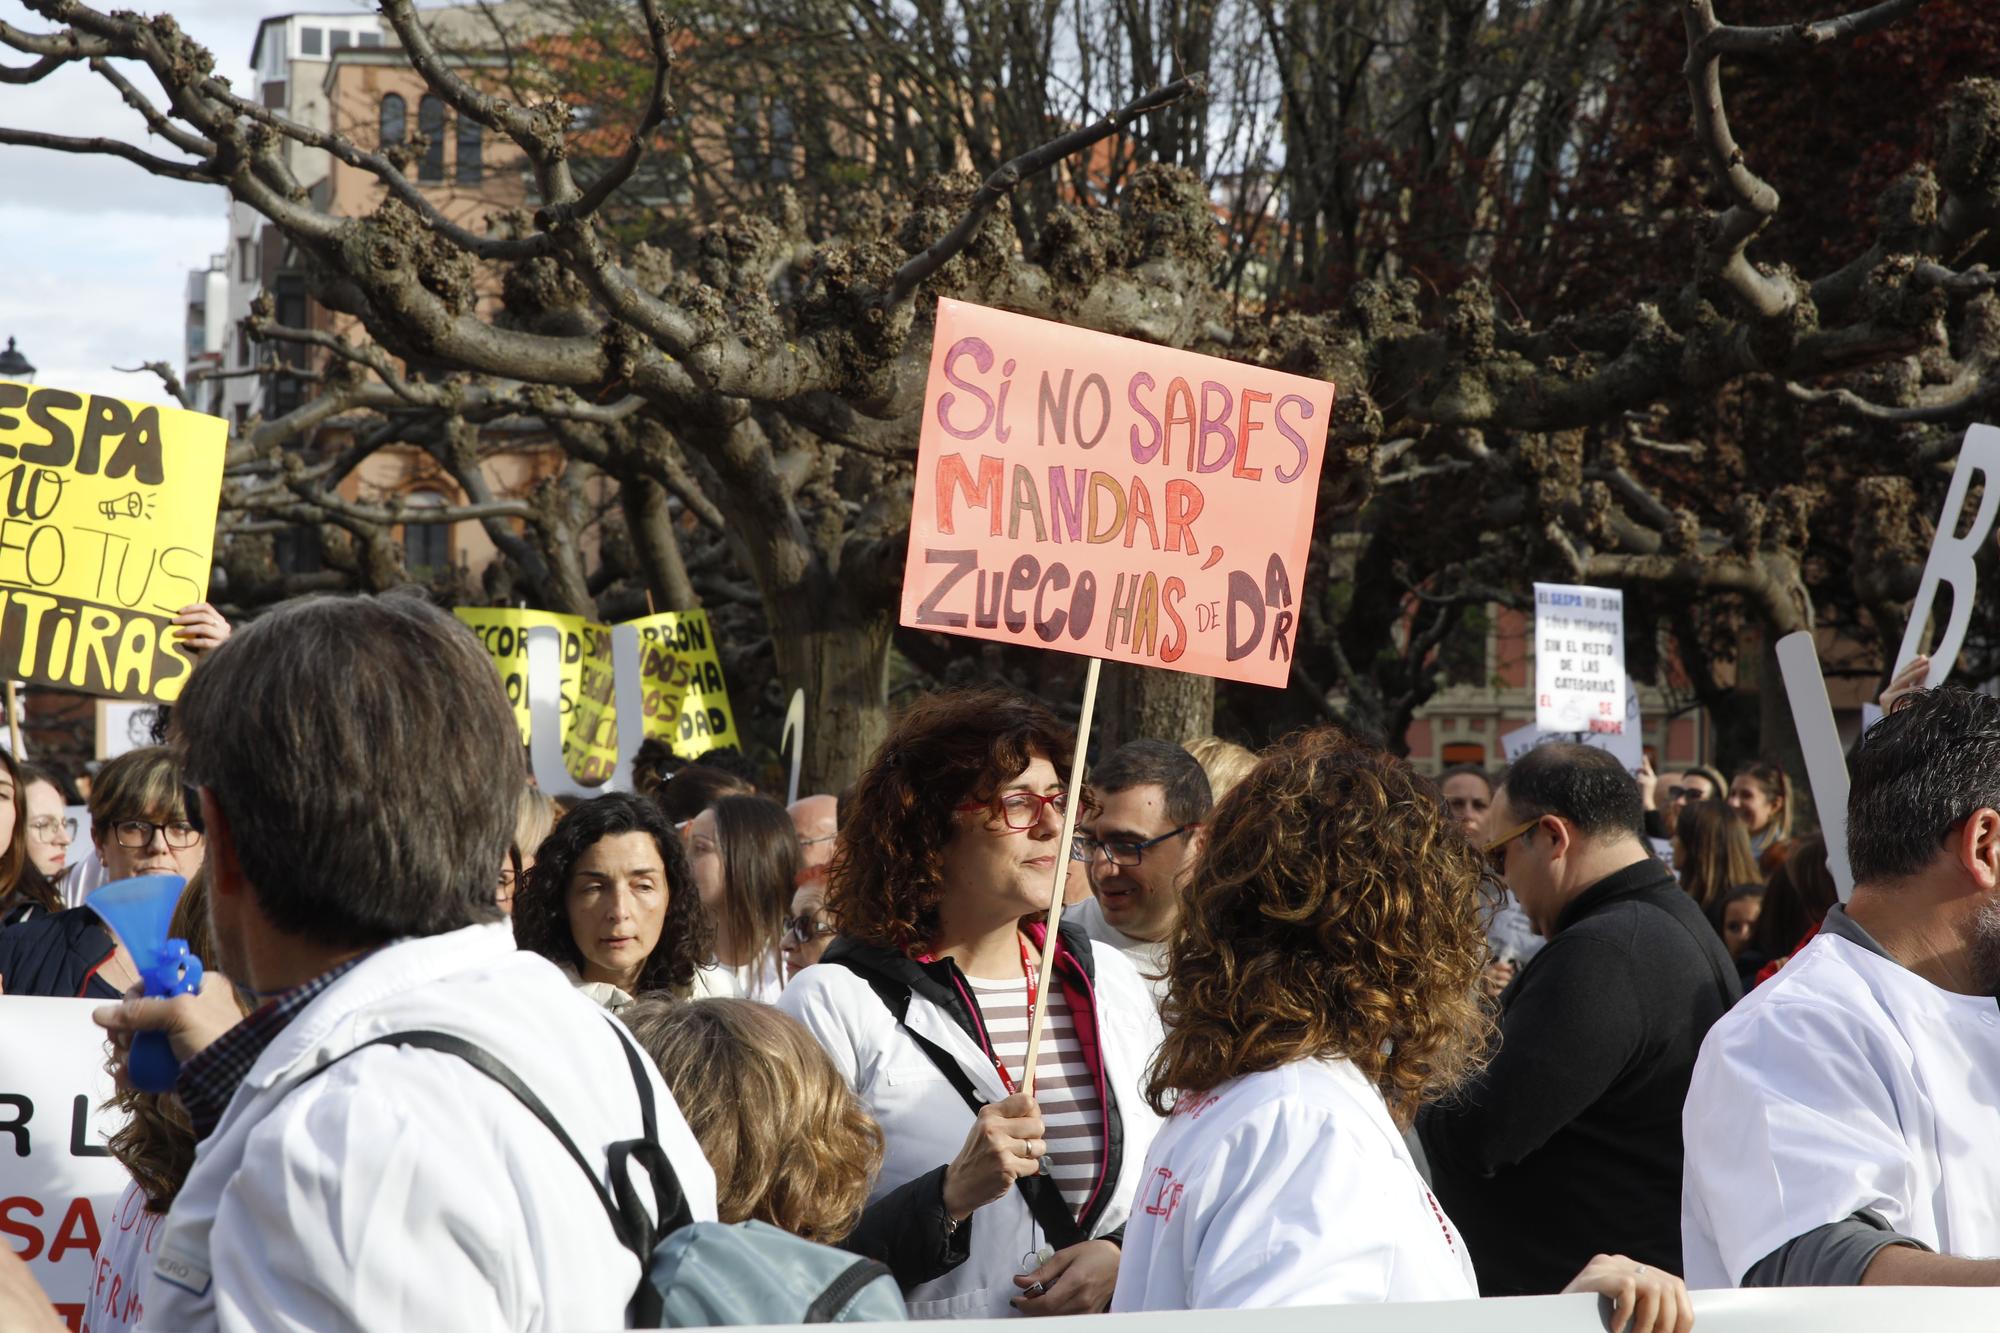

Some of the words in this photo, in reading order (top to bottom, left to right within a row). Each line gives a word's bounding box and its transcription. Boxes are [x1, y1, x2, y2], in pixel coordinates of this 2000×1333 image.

[1037, 368, 1111, 450] NO
[1128, 371, 1315, 484] SABES
[935, 452, 1224, 571] MANDAR,
[73, 525, 204, 614] TUS
[1105, 571, 1187, 663] HAS
[1196, 600, 1221, 633] DE
[1226, 552, 1294, 663] DAR
[1582, 660, 1599, 674] LAS
